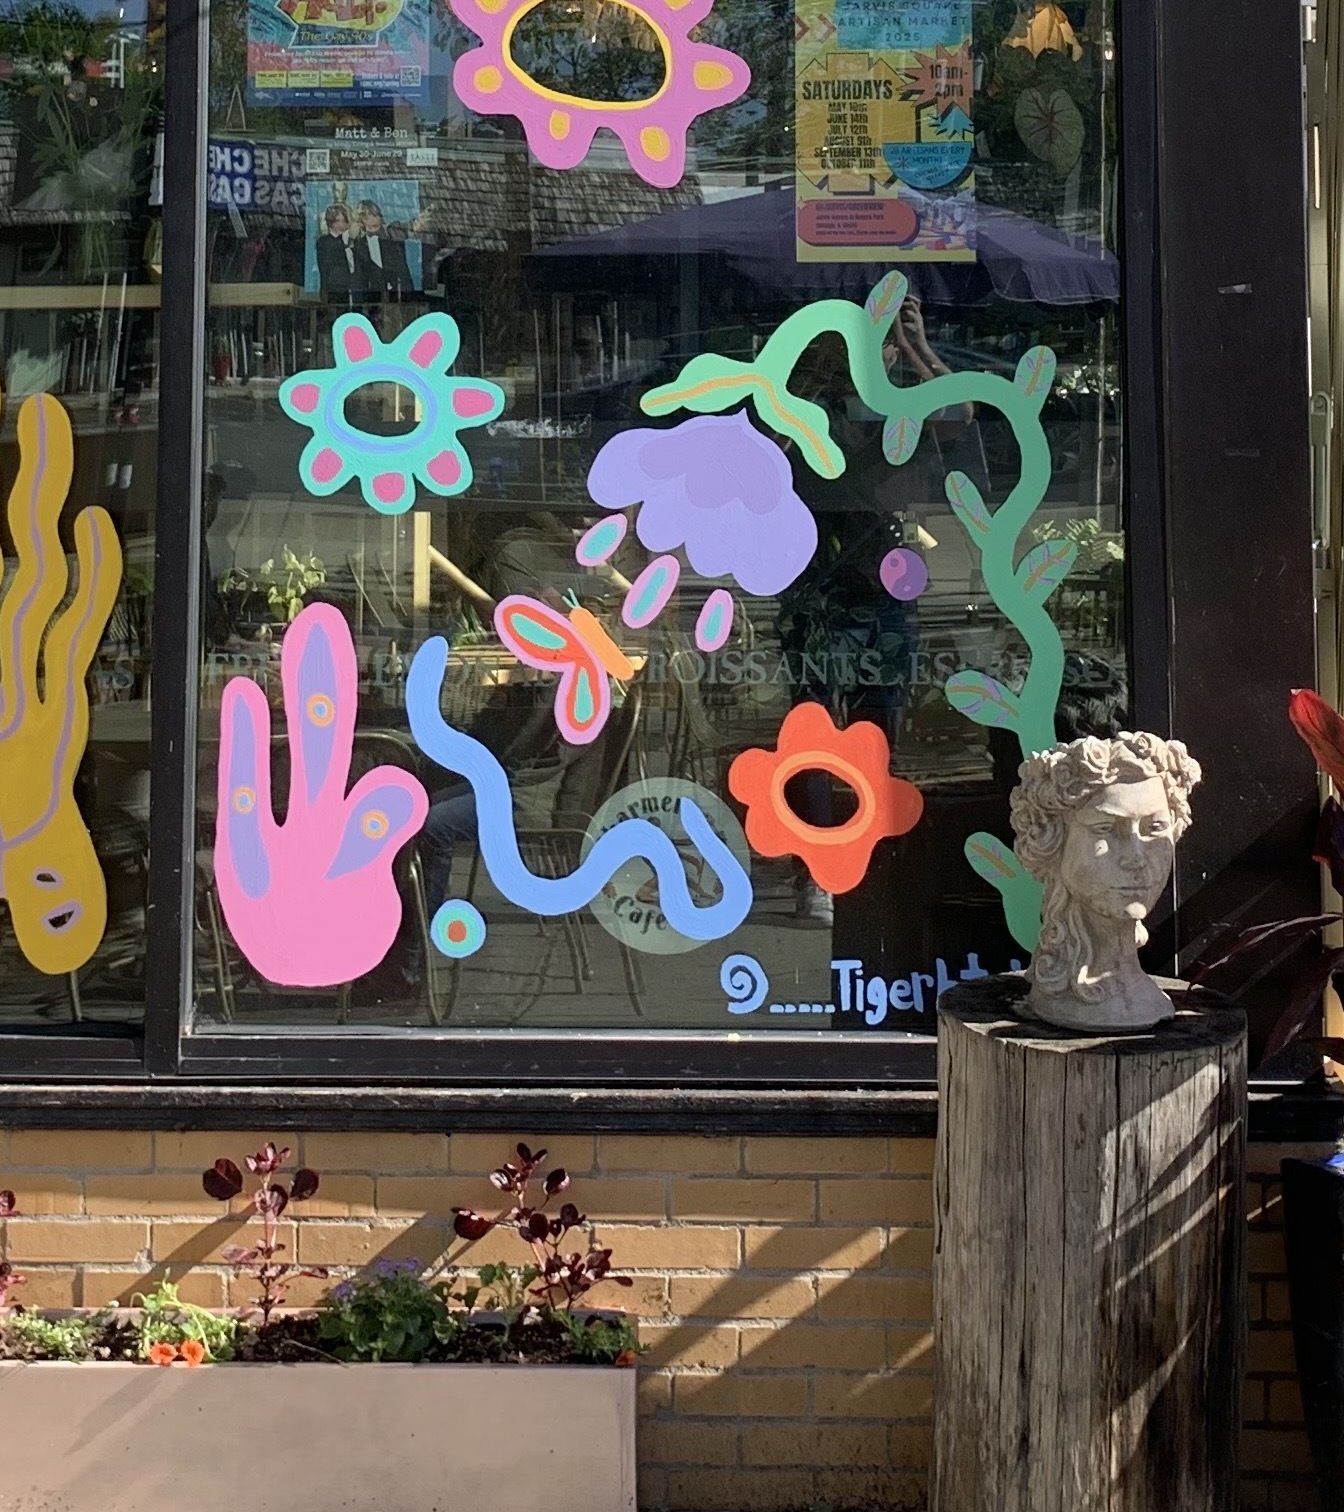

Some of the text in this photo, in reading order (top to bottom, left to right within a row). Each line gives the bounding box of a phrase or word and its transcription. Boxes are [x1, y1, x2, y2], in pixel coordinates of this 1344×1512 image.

[838, 16, 968, 27] ARTISAN MARKET
[885, 32, 921, 42] 2025
[801, 79, 893, 100] SATURDAYS
[828, 102, 847, 112] MAY
[827, 114, 848, 124] JUNE
[335, 127, 366, 139] Matt
[370, 127, 381, 138] &
[384, 126, 408, 138] Ben
[827, 125, 848, 134] JULY
[824, 136, 855, 146] AUGUST
[340, 149, 357, 160] May
[814, 147, 861, 158] SEPTEMBER
[821, 159, 857, 169] OCTOBER
[613, 895, 668, 935] Cafe
